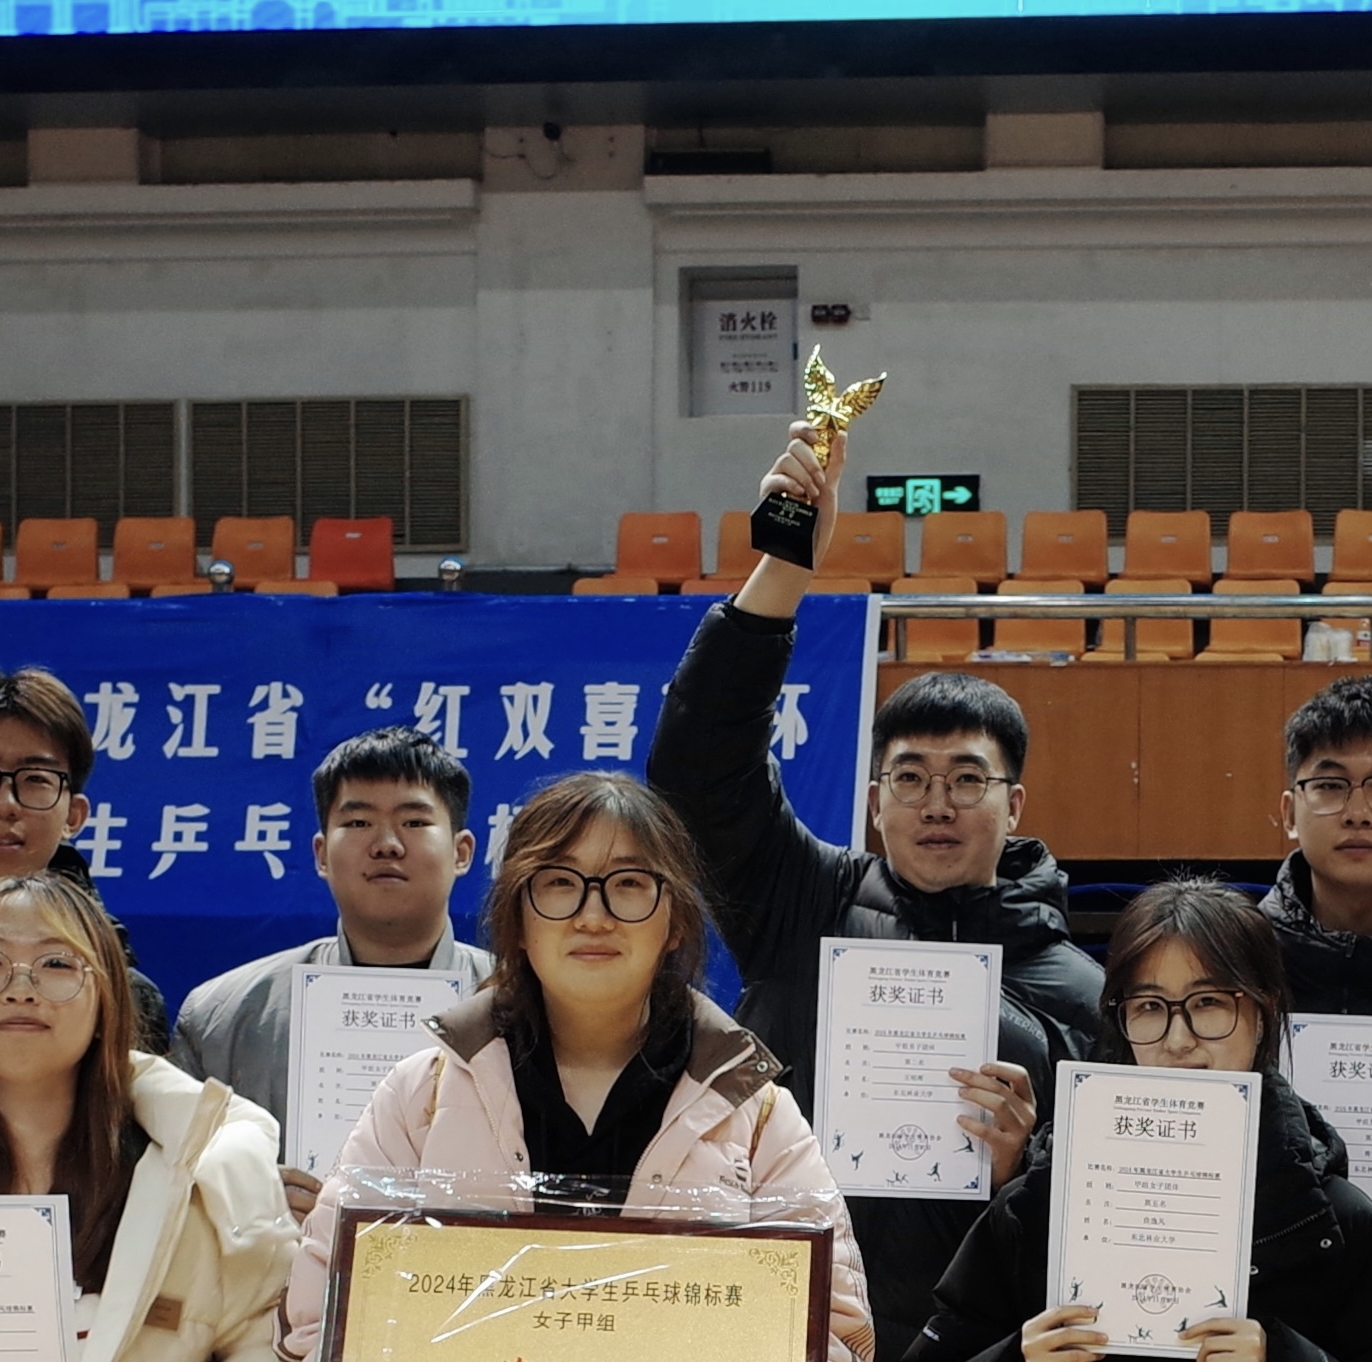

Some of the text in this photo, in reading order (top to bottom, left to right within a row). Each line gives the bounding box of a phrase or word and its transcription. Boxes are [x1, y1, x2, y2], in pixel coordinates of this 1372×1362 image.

[719, 311, 778, 332] 消火栓
[869, 966, 950, 978] 黑龙江省学生体育竞赛
[342, 992, 422, 1003] 黑龙江省学生体育竞赛
[869, 985, 944, 1005] 获奖证书
[342, 1010, 416, 1029] 获奖证书
[1114, 1095, 1205, 1110] 黑龙江省学生体育竞赛
[1114, 1115, 1197, 1140] 获奖证书
[408, 1272, 743, 1308] 2024年黑龙江省大学生乒乓球锦标赛
[532, 1311, 616, 1333] 女子甲组
